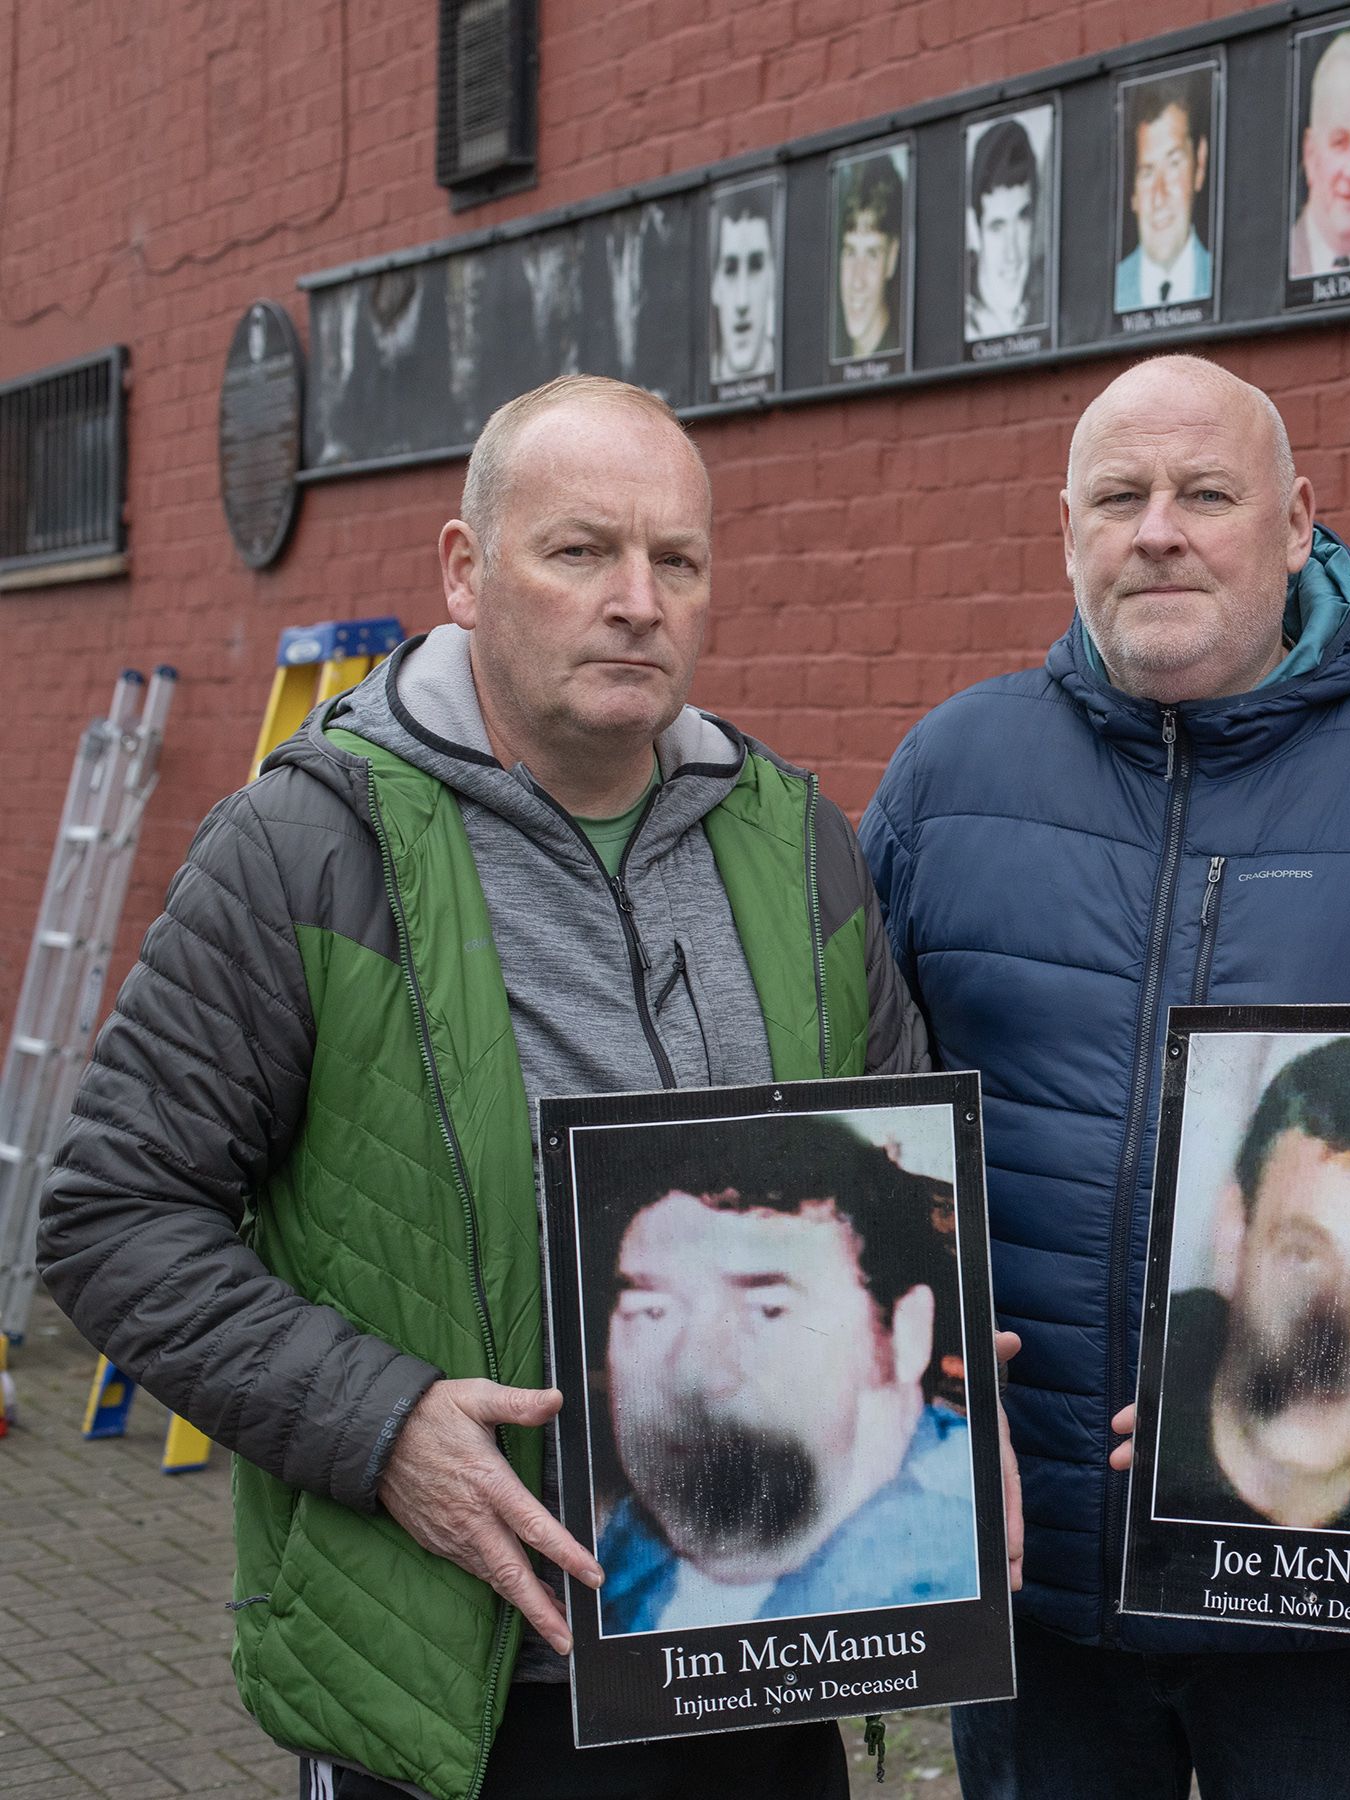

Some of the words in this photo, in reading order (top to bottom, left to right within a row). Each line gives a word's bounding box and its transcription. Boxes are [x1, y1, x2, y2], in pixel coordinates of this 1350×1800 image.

[1312, 279, 1338, 302] Jack
[1238, 870, 1313, 882] CRAGHOPPERS
[361, 1396, 411, 1489] COMPRESSLITE
[1210, 1540, 1262, 1580] Joe
[1203, 1589, 1273, 1616] Injured.
[1280, 1595, 1324, 1617] Now
[661, 1645, 727, 1689] Jim
[739, 1629, 927, 1673] McManus
[674, 1693, 757, 1720] Injured.
[764, 1684, 814, 1707] Now
[820, 1670, 919, 1700] Deceased
